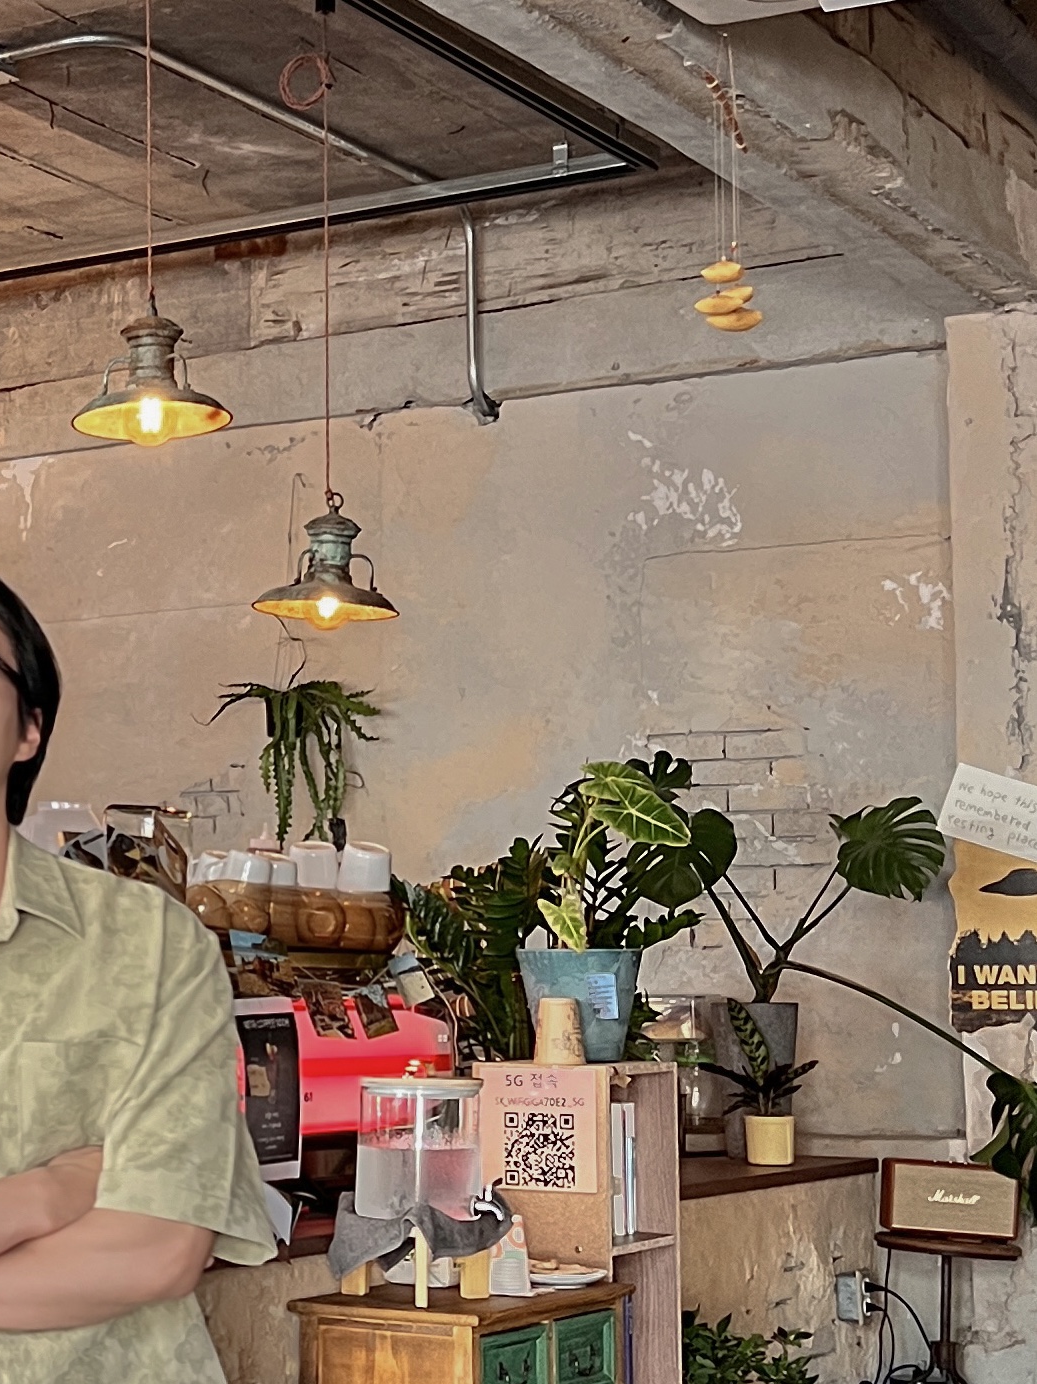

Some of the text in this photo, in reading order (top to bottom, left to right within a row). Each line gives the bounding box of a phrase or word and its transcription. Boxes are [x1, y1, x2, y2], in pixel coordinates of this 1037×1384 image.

[980, 783, 1008, 803] hope
[954, 799, 1031, 832] remembered
[947, 814, 994, 841] resting
[957, 964, 1037, 985] I WAN
[971, 989, 1037, 1010] BELI
[505, 1073, 559, 1088] 5G 접속
[928, 1189, 981, 1205] Marshall
